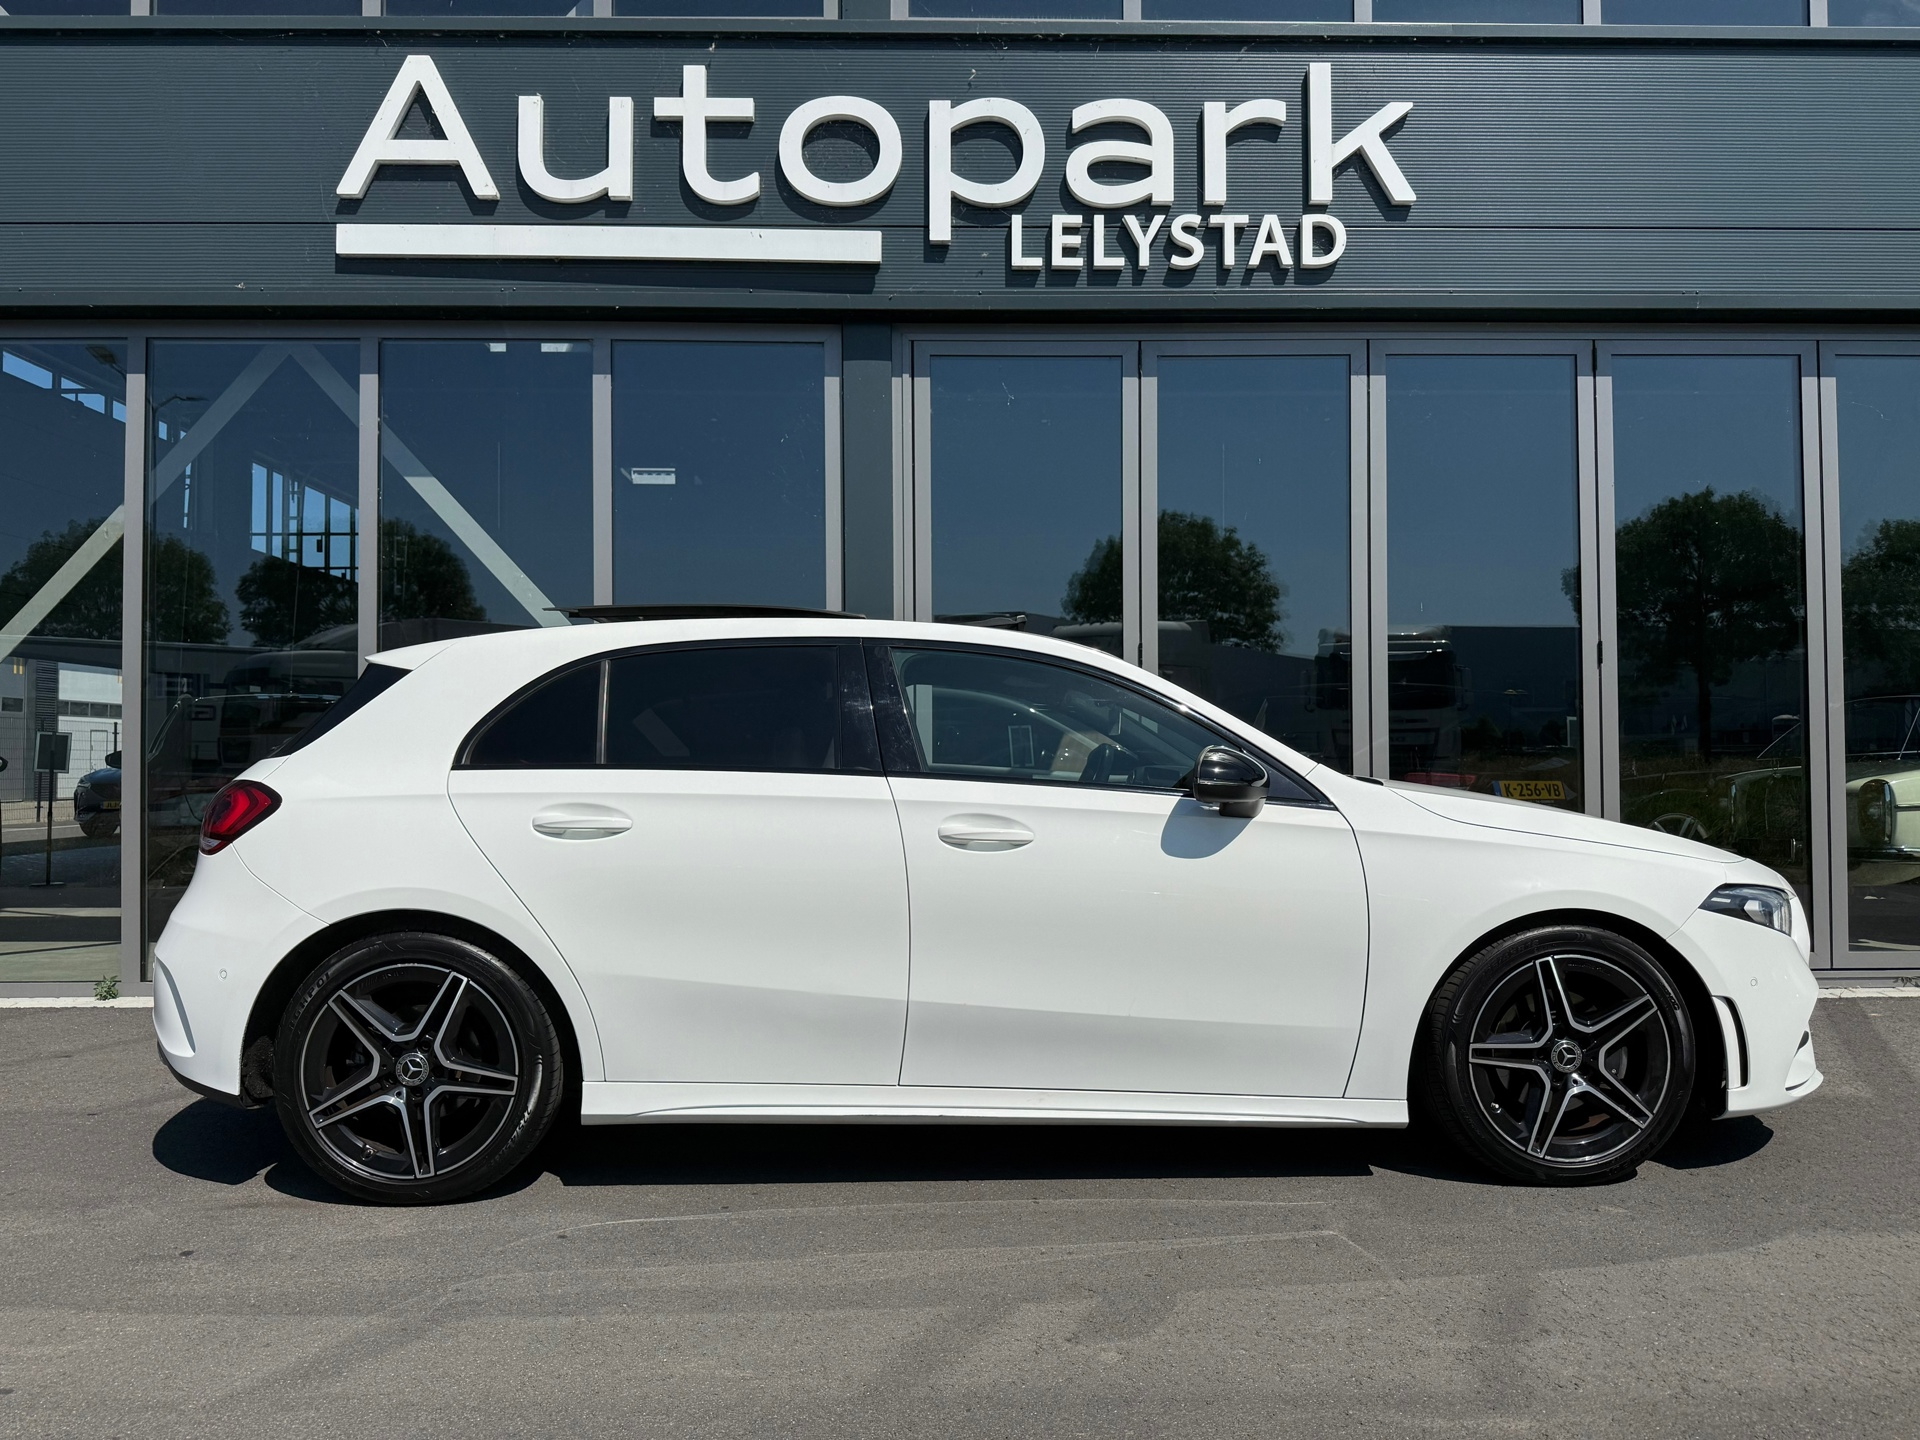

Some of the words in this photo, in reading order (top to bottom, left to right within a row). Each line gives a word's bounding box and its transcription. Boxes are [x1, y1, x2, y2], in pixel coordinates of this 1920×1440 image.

[336, 54, 1418, 246] Autopark
[1010, 213, 1347, 271] LELYSTAD
[1503, 782, 1561, 797] K-256-VB
